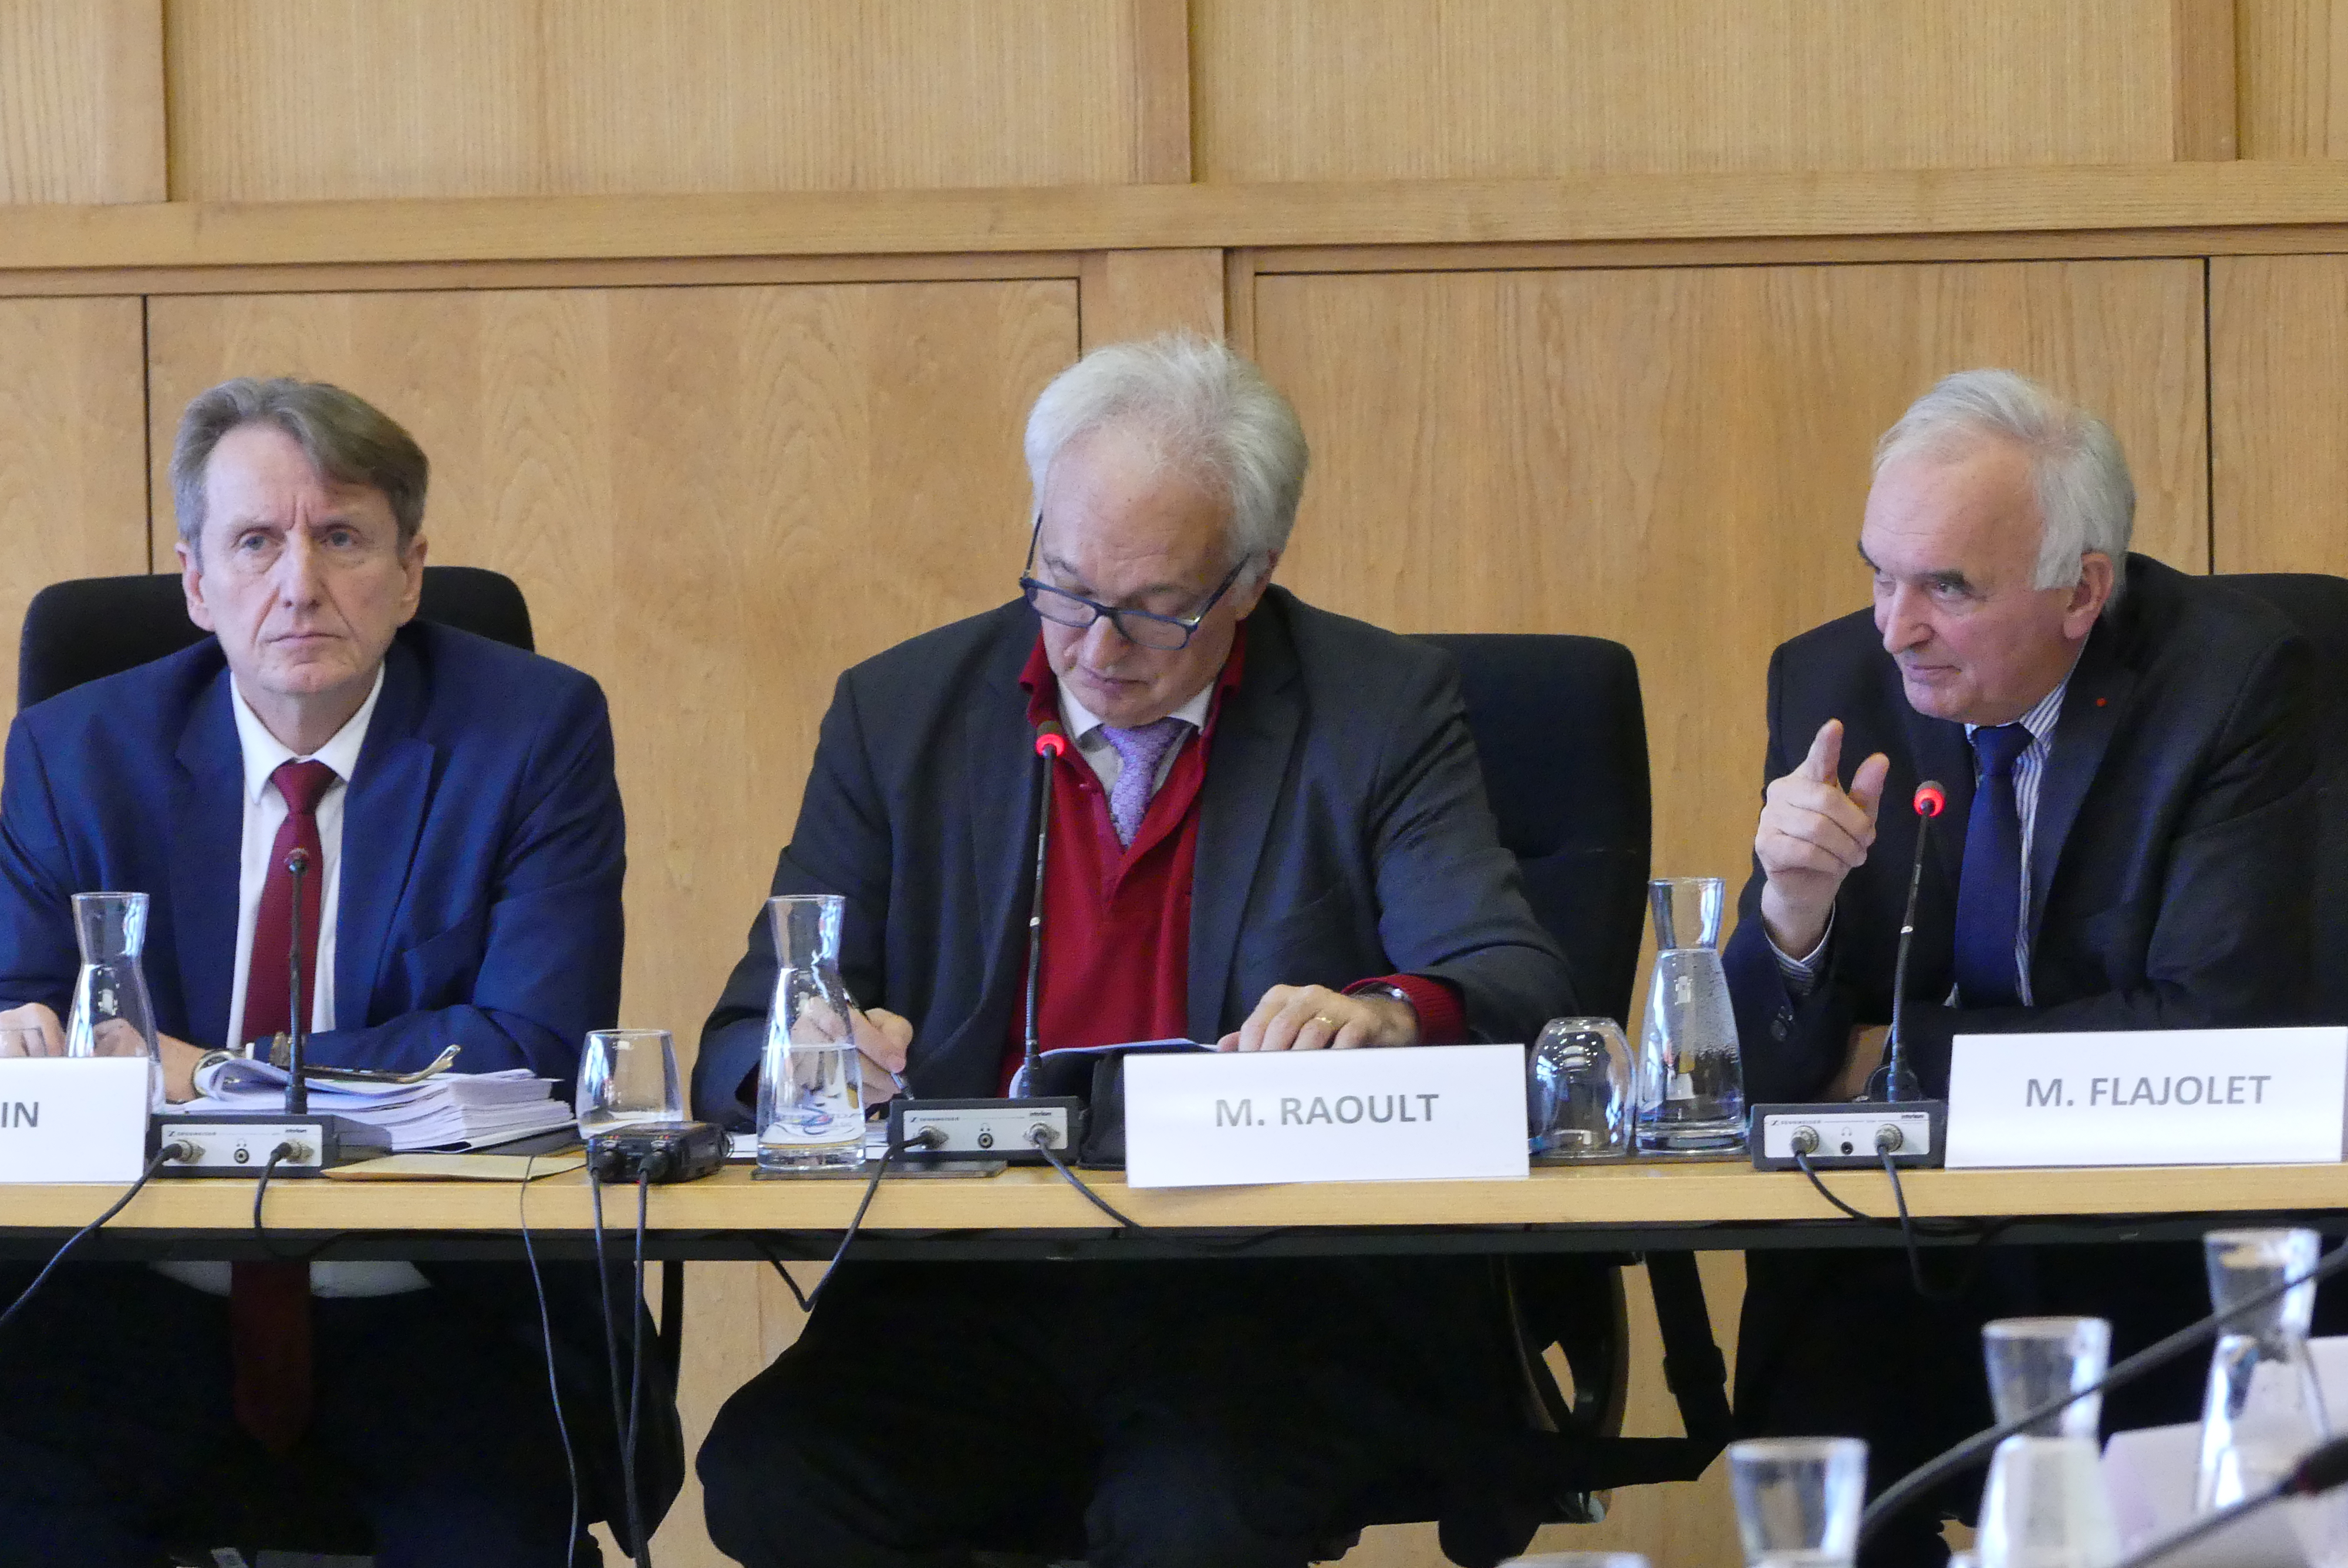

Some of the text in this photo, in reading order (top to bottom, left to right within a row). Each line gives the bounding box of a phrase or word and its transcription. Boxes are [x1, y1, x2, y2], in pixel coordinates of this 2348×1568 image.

[2027, 1076, 2271, 1107] M. FLAJOLET
[1217, 1094, 1439, 1127] M. RAOULT
